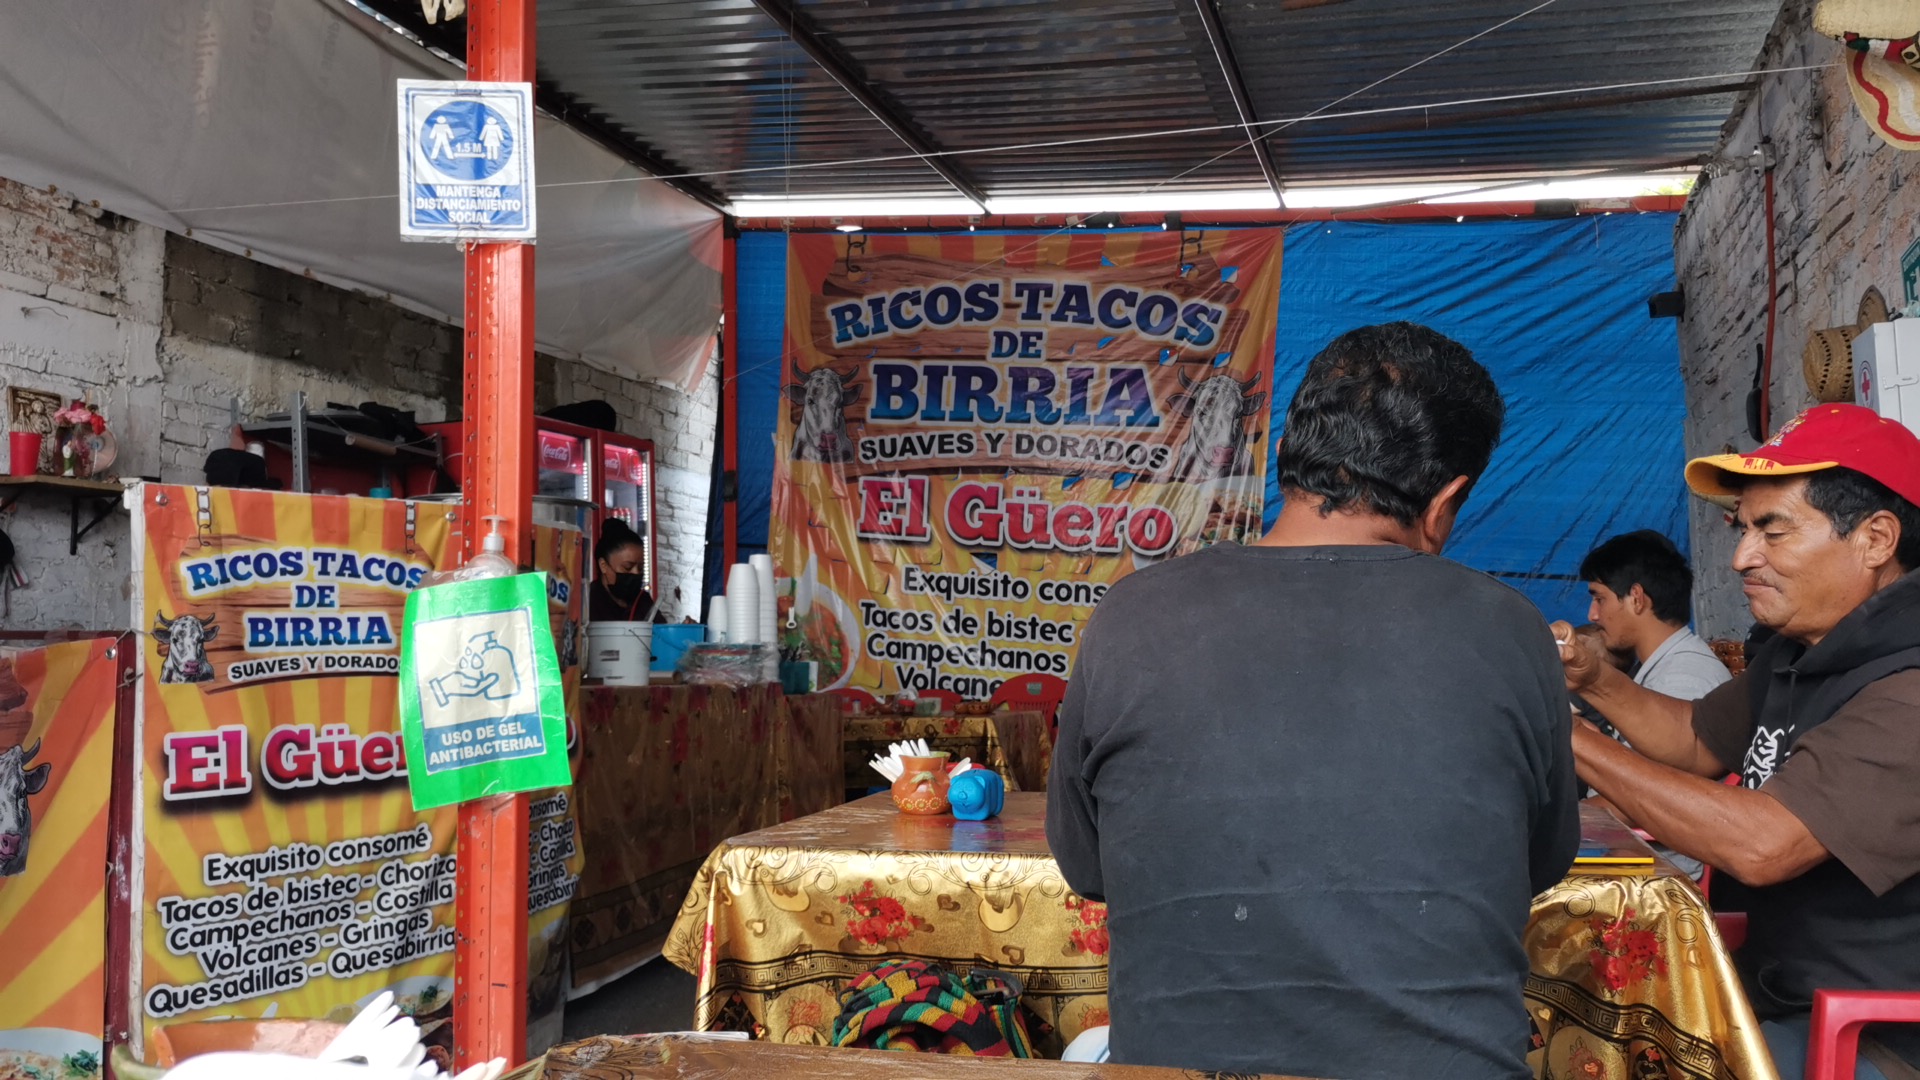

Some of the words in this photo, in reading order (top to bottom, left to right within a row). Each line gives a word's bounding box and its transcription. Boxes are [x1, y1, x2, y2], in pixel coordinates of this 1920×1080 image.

[455, 143, 472, 153] 1.5
[473, 143, 482, 153] M
[415, 198, 521, 212] DISTANCIAMIENTO
[436, 185, 501, 198] MANTENGA
[448, 211, 491, 223] SOCIAL
[830, 282, 1001, 343] RICOS
[1014, 281, 1224, 345] TACOS
[990, 330, 1044, 359] DE
[869, 363, 1161, 428] BIRRIA
[860, 433, 975, 461] SUAVES
[984, 432, 1005, 452] Y
[1015, 434, 1170, 470] DORADOS
[859, 476, 929, 541] El
[946, 482, 1176, 554] Güero
[186, 550, 304, 591] RICOS
[314, 551, 428, 590] TACOS
[904, 567, 1030, 602] Exquisito
[1038, 582, 1108, 603] cons
[294, 584, 336, 608] DE
[248, 615, 393, 647] BIRRIA
[860, 602, 934, 631] Tacos
[942, 608, 978, 635] de
[987, 611, 1073, 643] bistec
[231, 656, 301, 681] SUAVES
[306, 656, 319, 670] Y
[324, 655, 399, 672] DORADO
[867, 633, 1067, 673] Campechanos
[896, 665, 1003, 698] Volcane
[429, 735, 543, 766] ANTIBACTERIAL
[441, 728, 473, 746] USO
[476, 725, 496, 740] DE
[498, 721, 527, 737] GEL
[168, 729, 248, 795] El
[207, 846, 321, 882] Exquisito
[328, 826, 429, 863] consomé
[161, 896, 239, 925] Tacos
[247, 886, 280, 911] de
[287, 877, 358, 905] bistec
[380, 857, 457, 886] Chorizo
[170, 903, 351, 950] Campechanos
[376, 880, 453, 912] Costilla
[201, 936, 317, 974] Volcanes
[343, 912, 429, 945] Gringas
[149, 965, 304, 1013] Quesadillas
[332, 929, 457, 974] Quesabirria
